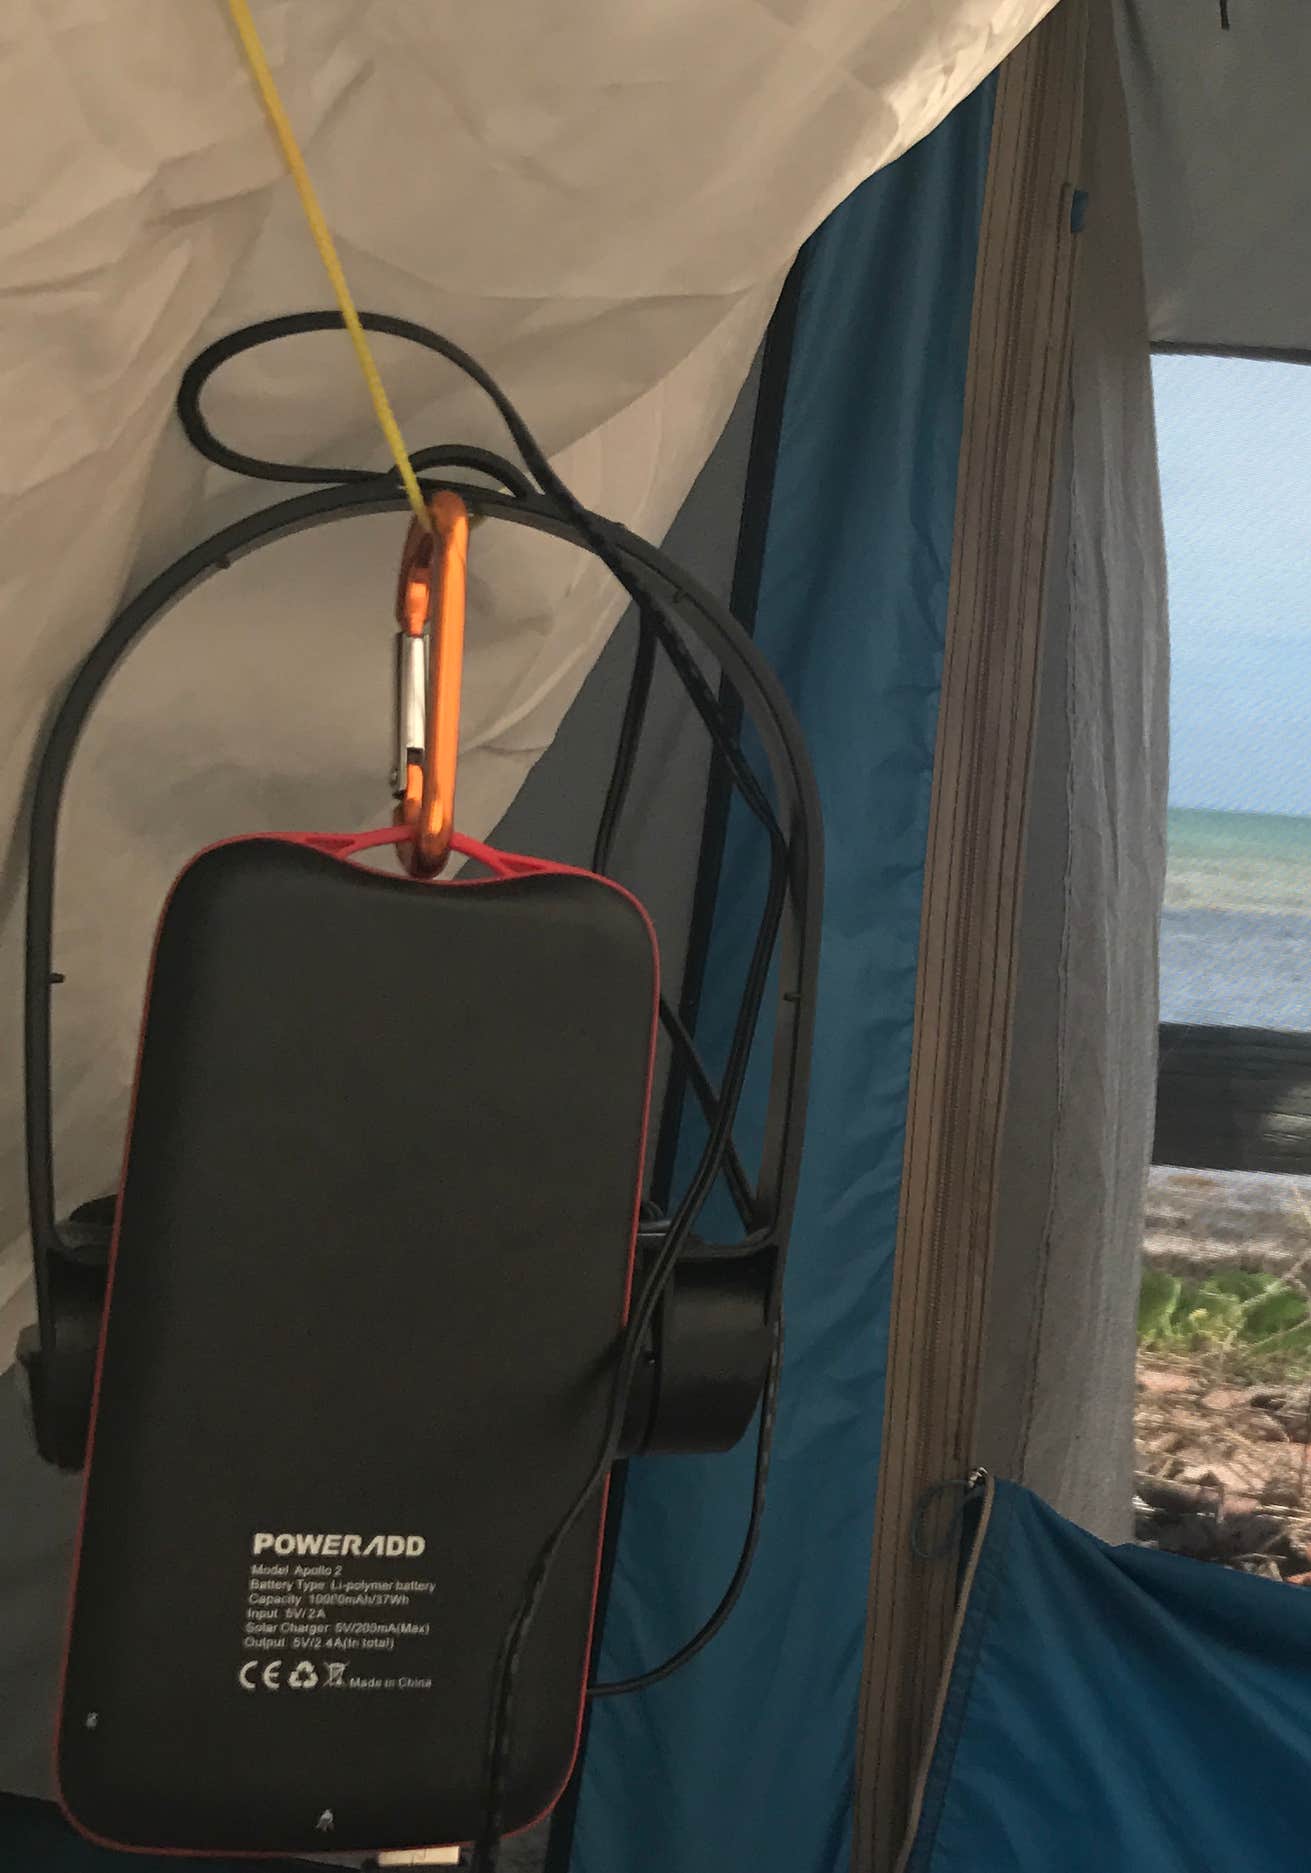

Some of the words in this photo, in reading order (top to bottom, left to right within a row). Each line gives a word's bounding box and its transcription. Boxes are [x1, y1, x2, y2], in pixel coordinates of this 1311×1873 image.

[253, 1532, 426, 1557] POWERADD
[294, 1565, 332, 1578] Apollo
[334, 1565, 343, 1576] 2
[249, 1579, 293, 1592] Battery
[330, 1580, 394, 1593] Li-polymer
[395, 1580, 437, 1593] battery
[245, 1621, 278, 1634] Solar
[350, 1677, 382, 1689] Made
[384, 1678, 395, 1689] in
[398, 1677, 432, 1689] China
